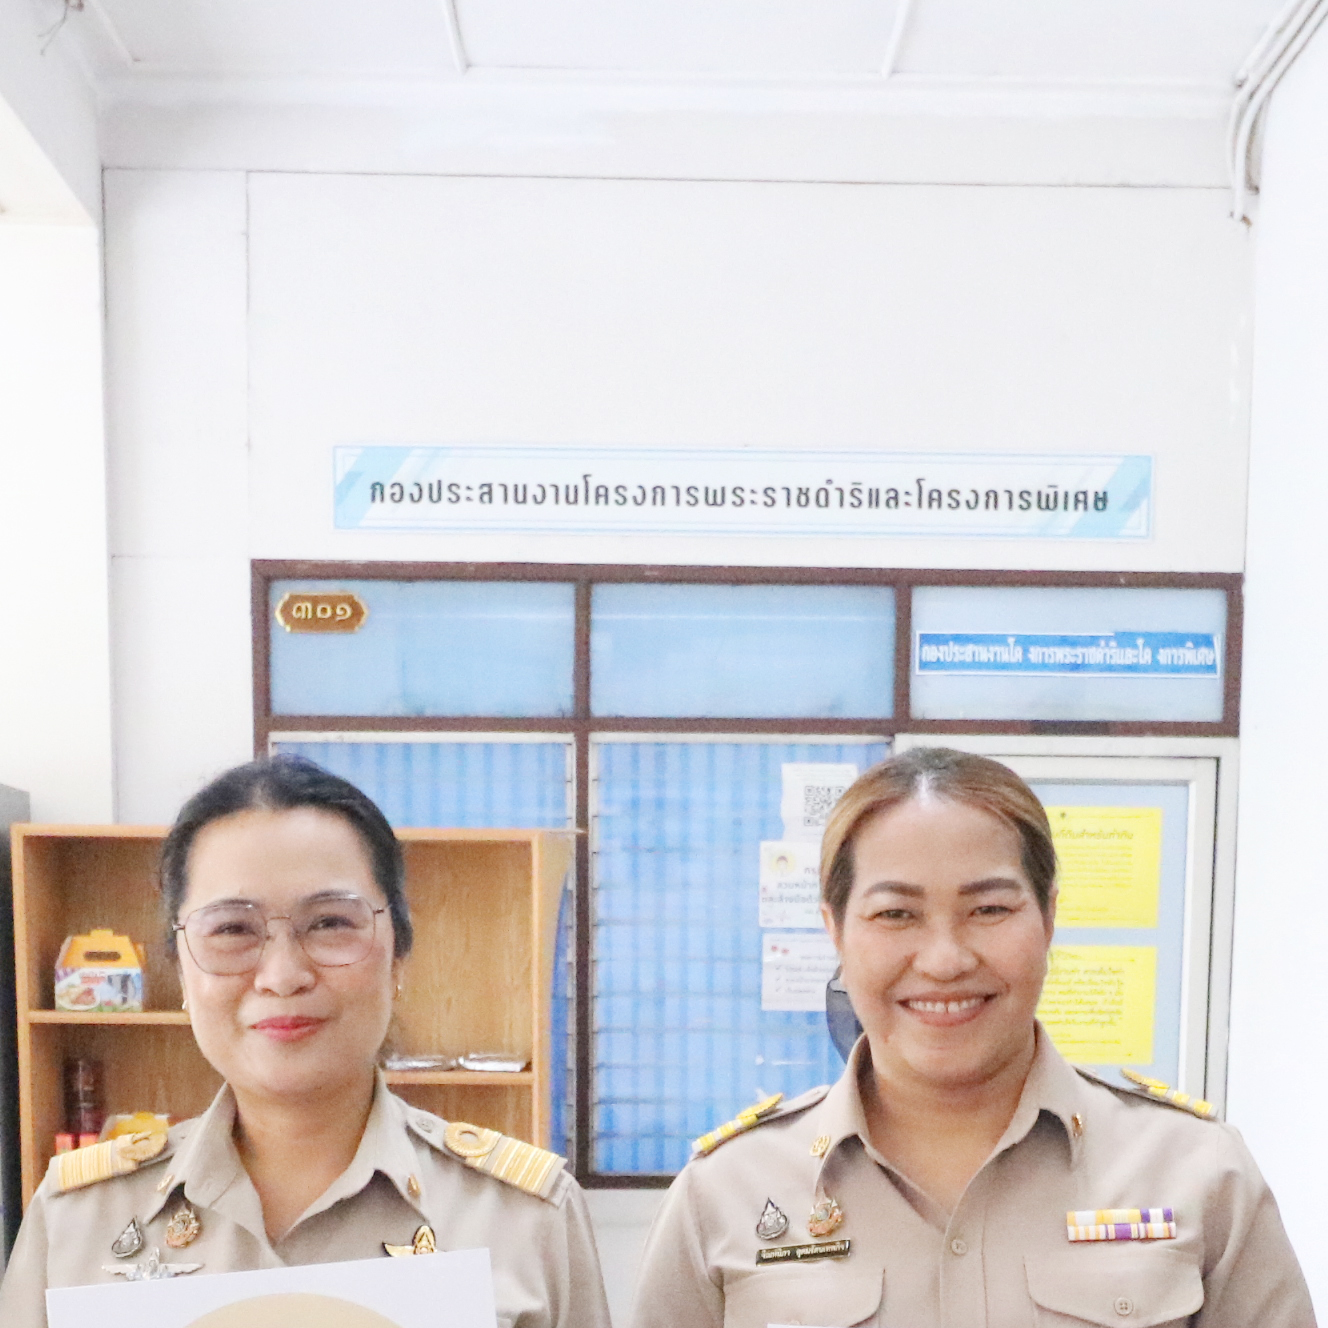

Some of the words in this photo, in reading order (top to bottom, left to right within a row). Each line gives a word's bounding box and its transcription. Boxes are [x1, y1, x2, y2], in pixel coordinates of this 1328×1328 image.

[370, 474, 1109, 513] กองประสานงานโครงการพระราชดำริและโครงการพิเศษ
[292, 602, 353, 622] ๓๐๑
